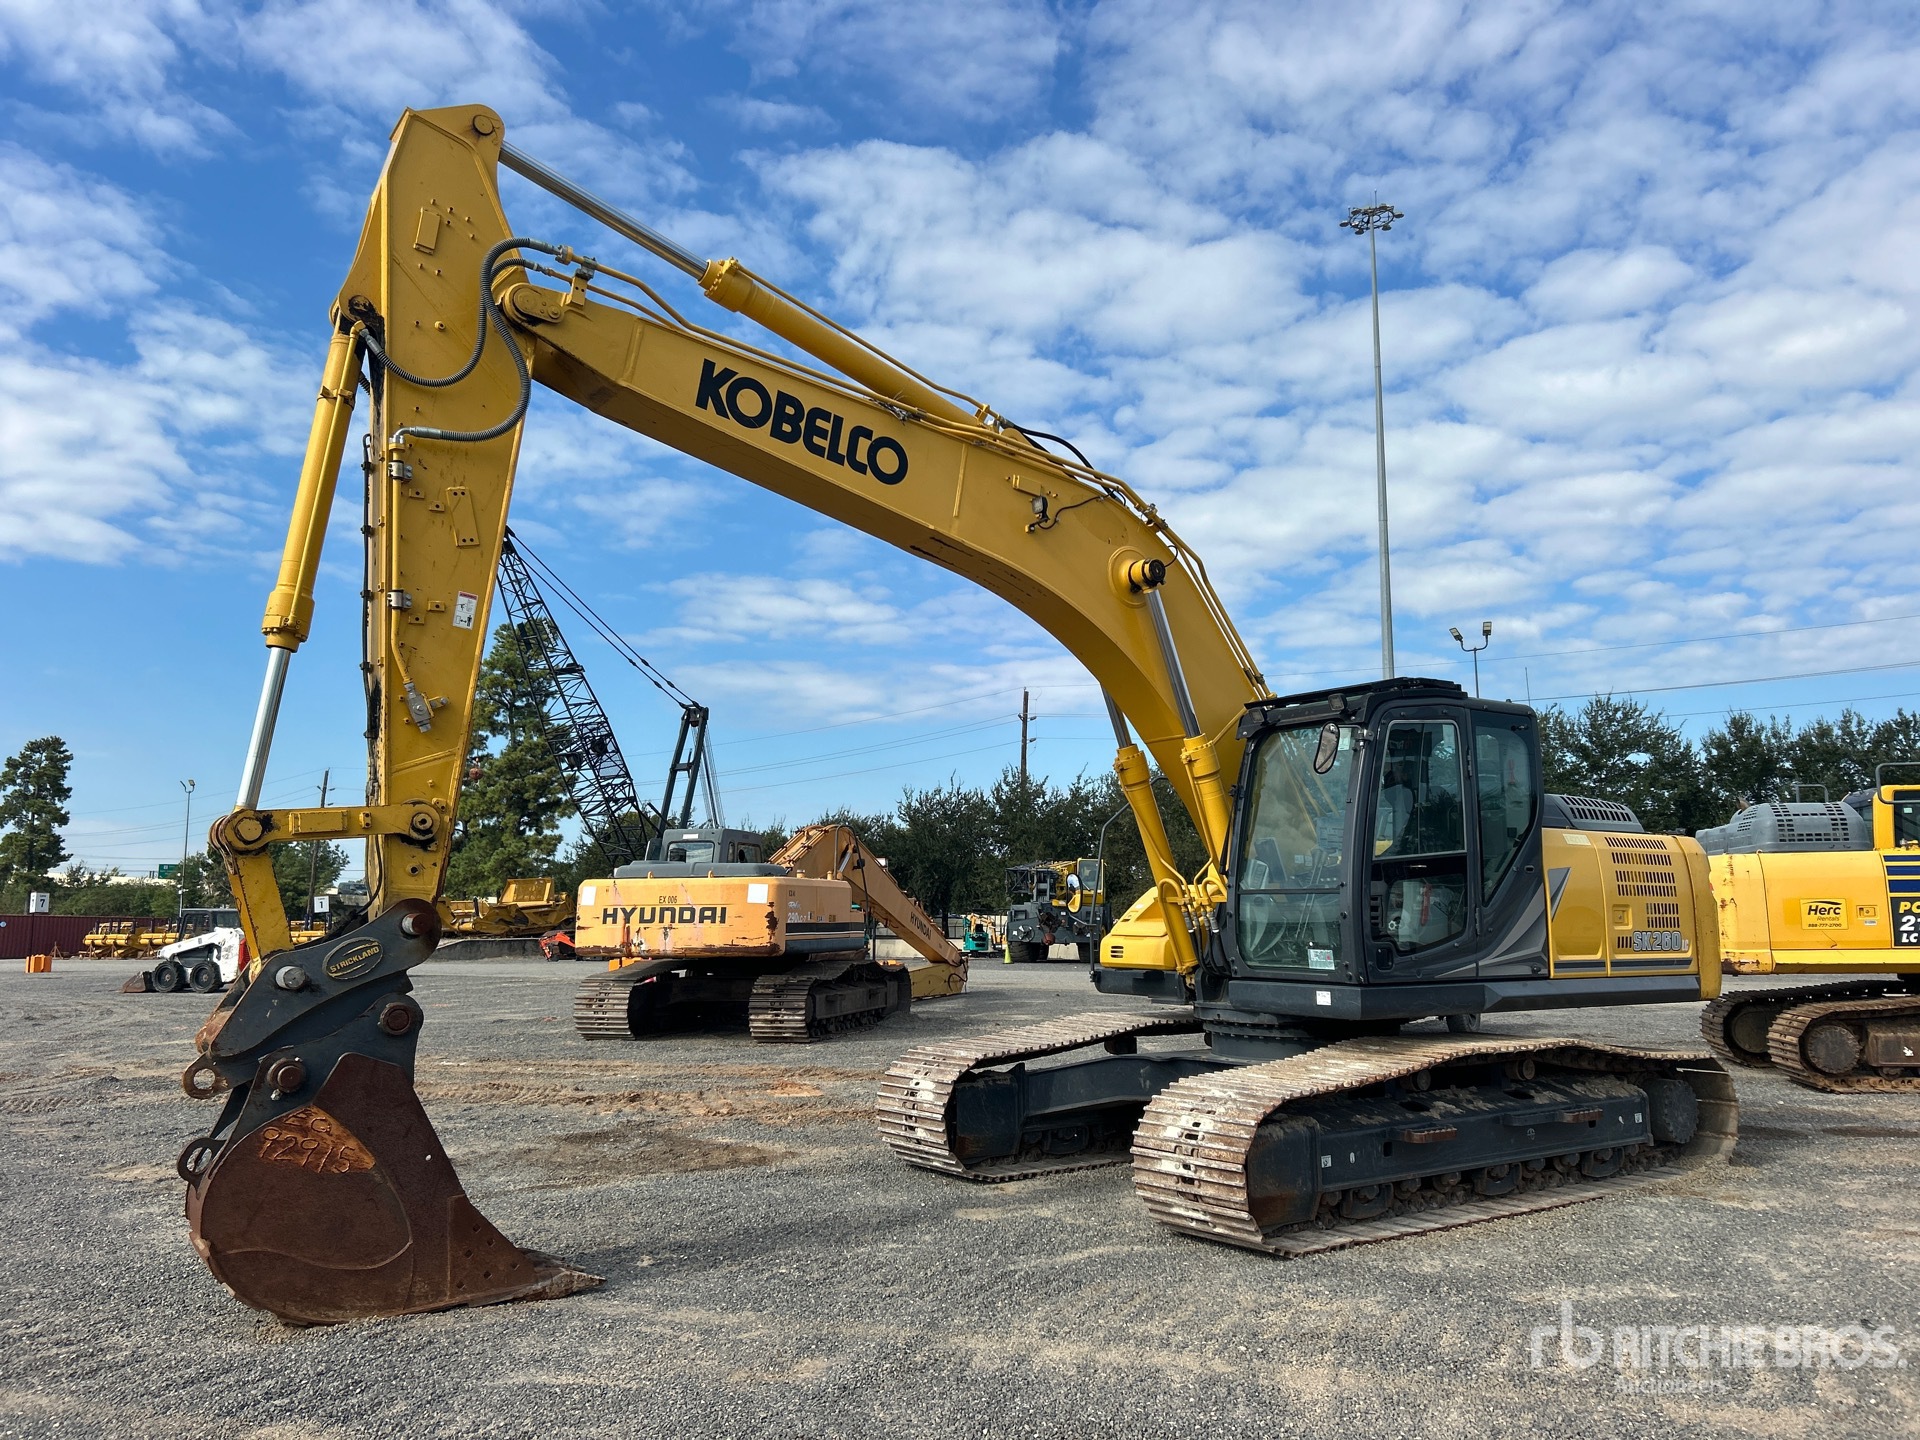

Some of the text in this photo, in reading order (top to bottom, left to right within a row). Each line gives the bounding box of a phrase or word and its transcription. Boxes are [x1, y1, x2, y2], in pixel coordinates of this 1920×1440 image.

[695, 358, 909, 486] KOBELCO
[40, 899, 46, 908] 7
[1807, 904, 1842, 916] Herc
[602, 906, 728, 925] HYUNDAI
[910, 911, 932, 941] HYUNDAI
[1632, 930, 1682, 952] SK260
[1901, 932, 1919, 943] LC
[329, 946, 381, 973] STRICKLAND
[259, 1127, 355, 1174] 92915
